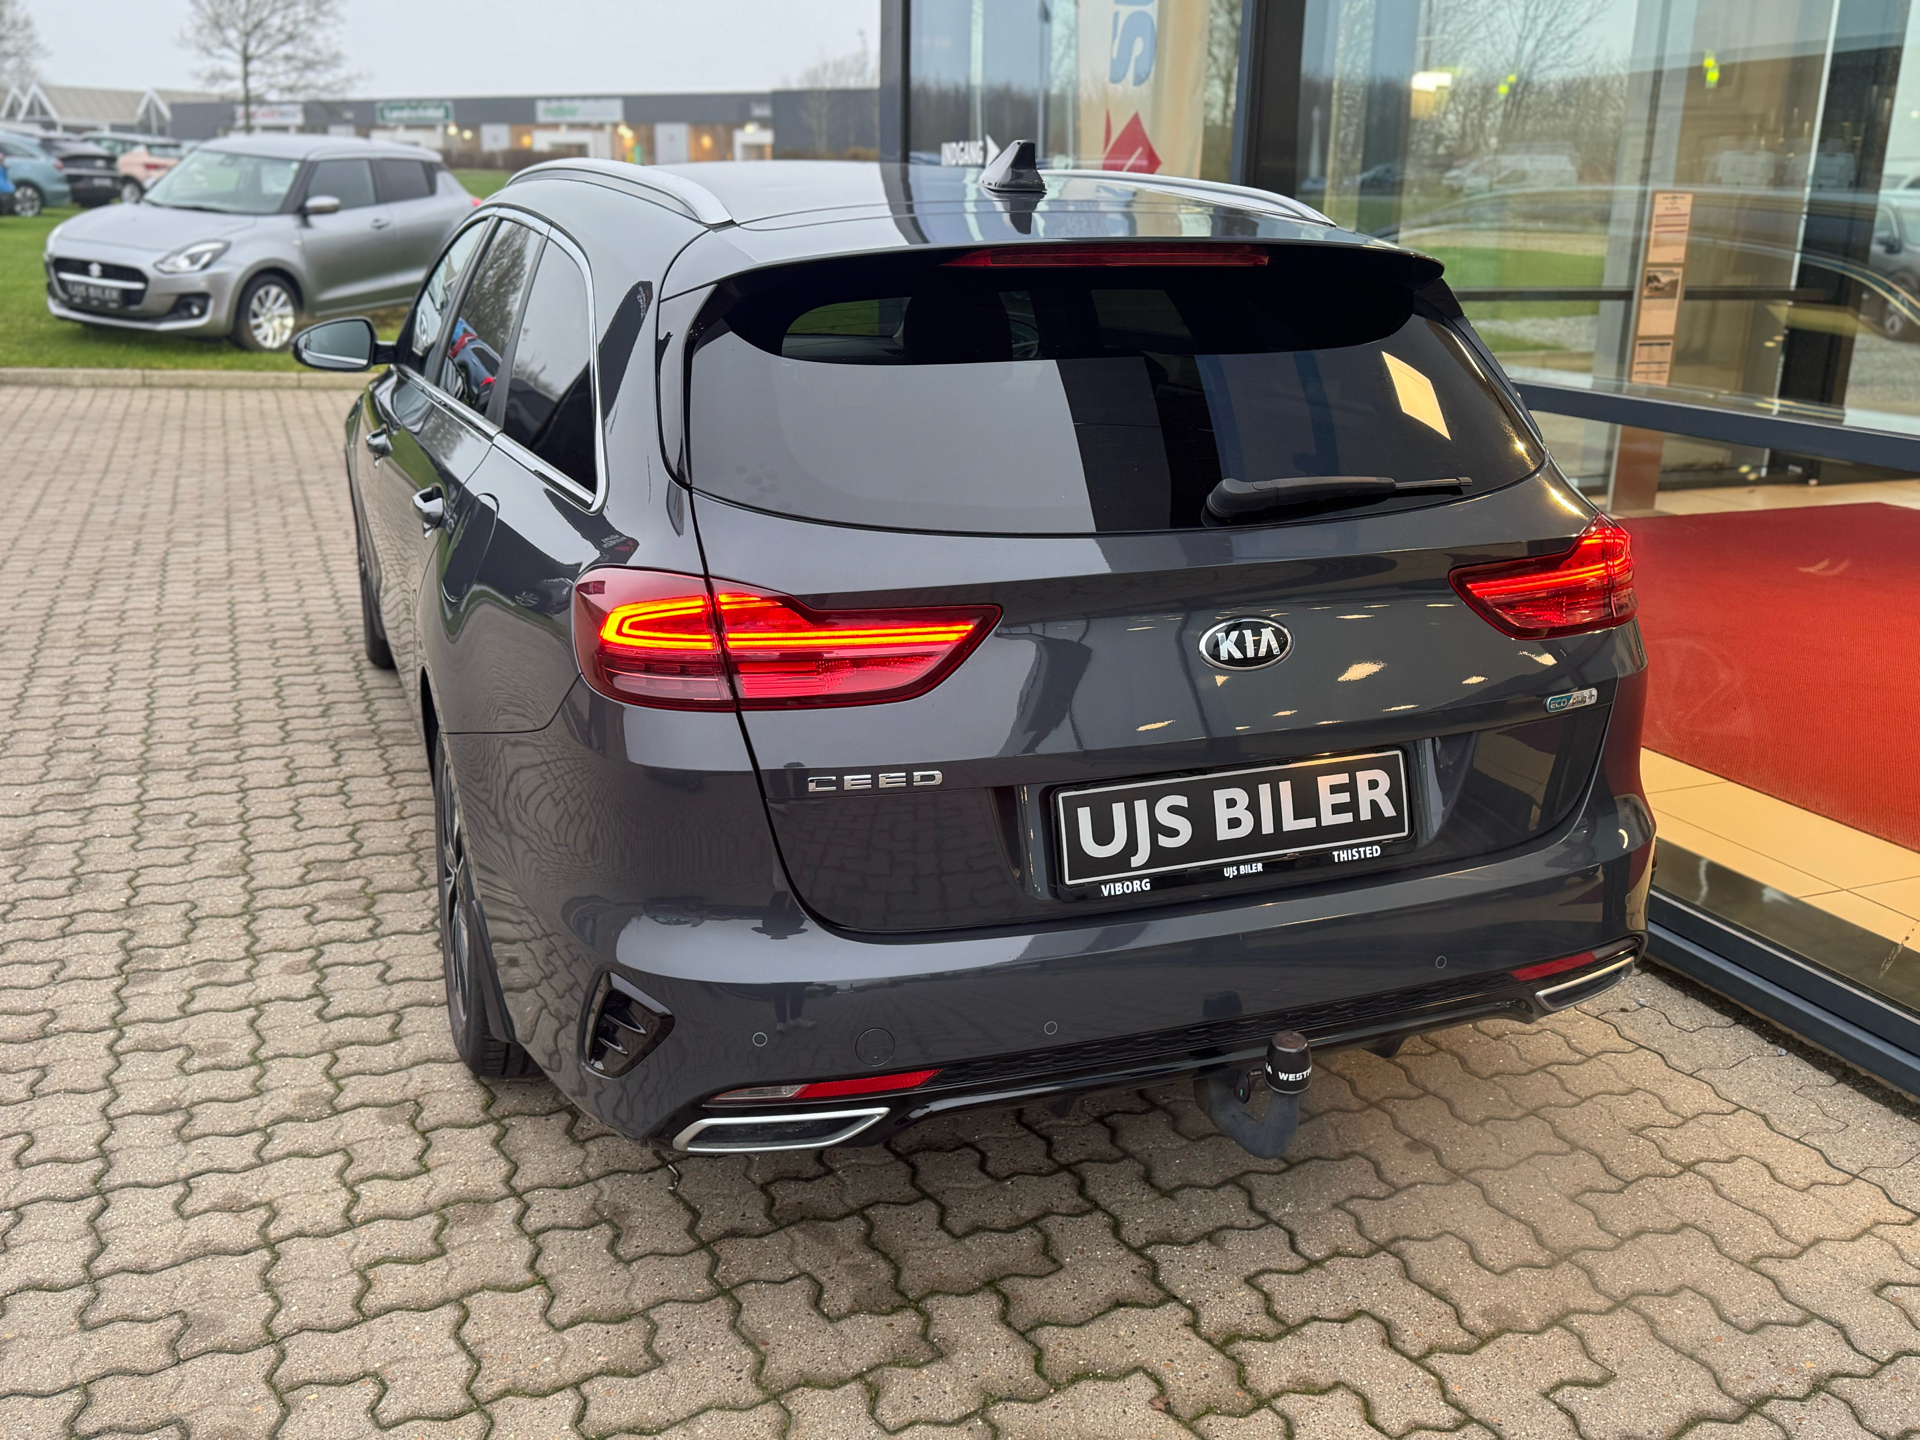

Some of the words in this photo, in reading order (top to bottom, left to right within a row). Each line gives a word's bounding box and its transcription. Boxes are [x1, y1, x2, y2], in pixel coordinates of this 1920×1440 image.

[1216, 627, 1280, 661] KIA
[1550, 698, 1568, 709] ECO
[807, 770, 943, 793] CEED
[1076, 794, 1193, 867] UJS
[1213, 769, 1397, 842] BILER
[1332, 846, 1381, 863] THISTED
[1223, 866, 1238, 879] UJS
[1239, 862, 1264, 876] BILER
[1100, 878, 1151, 898] VIBORG
